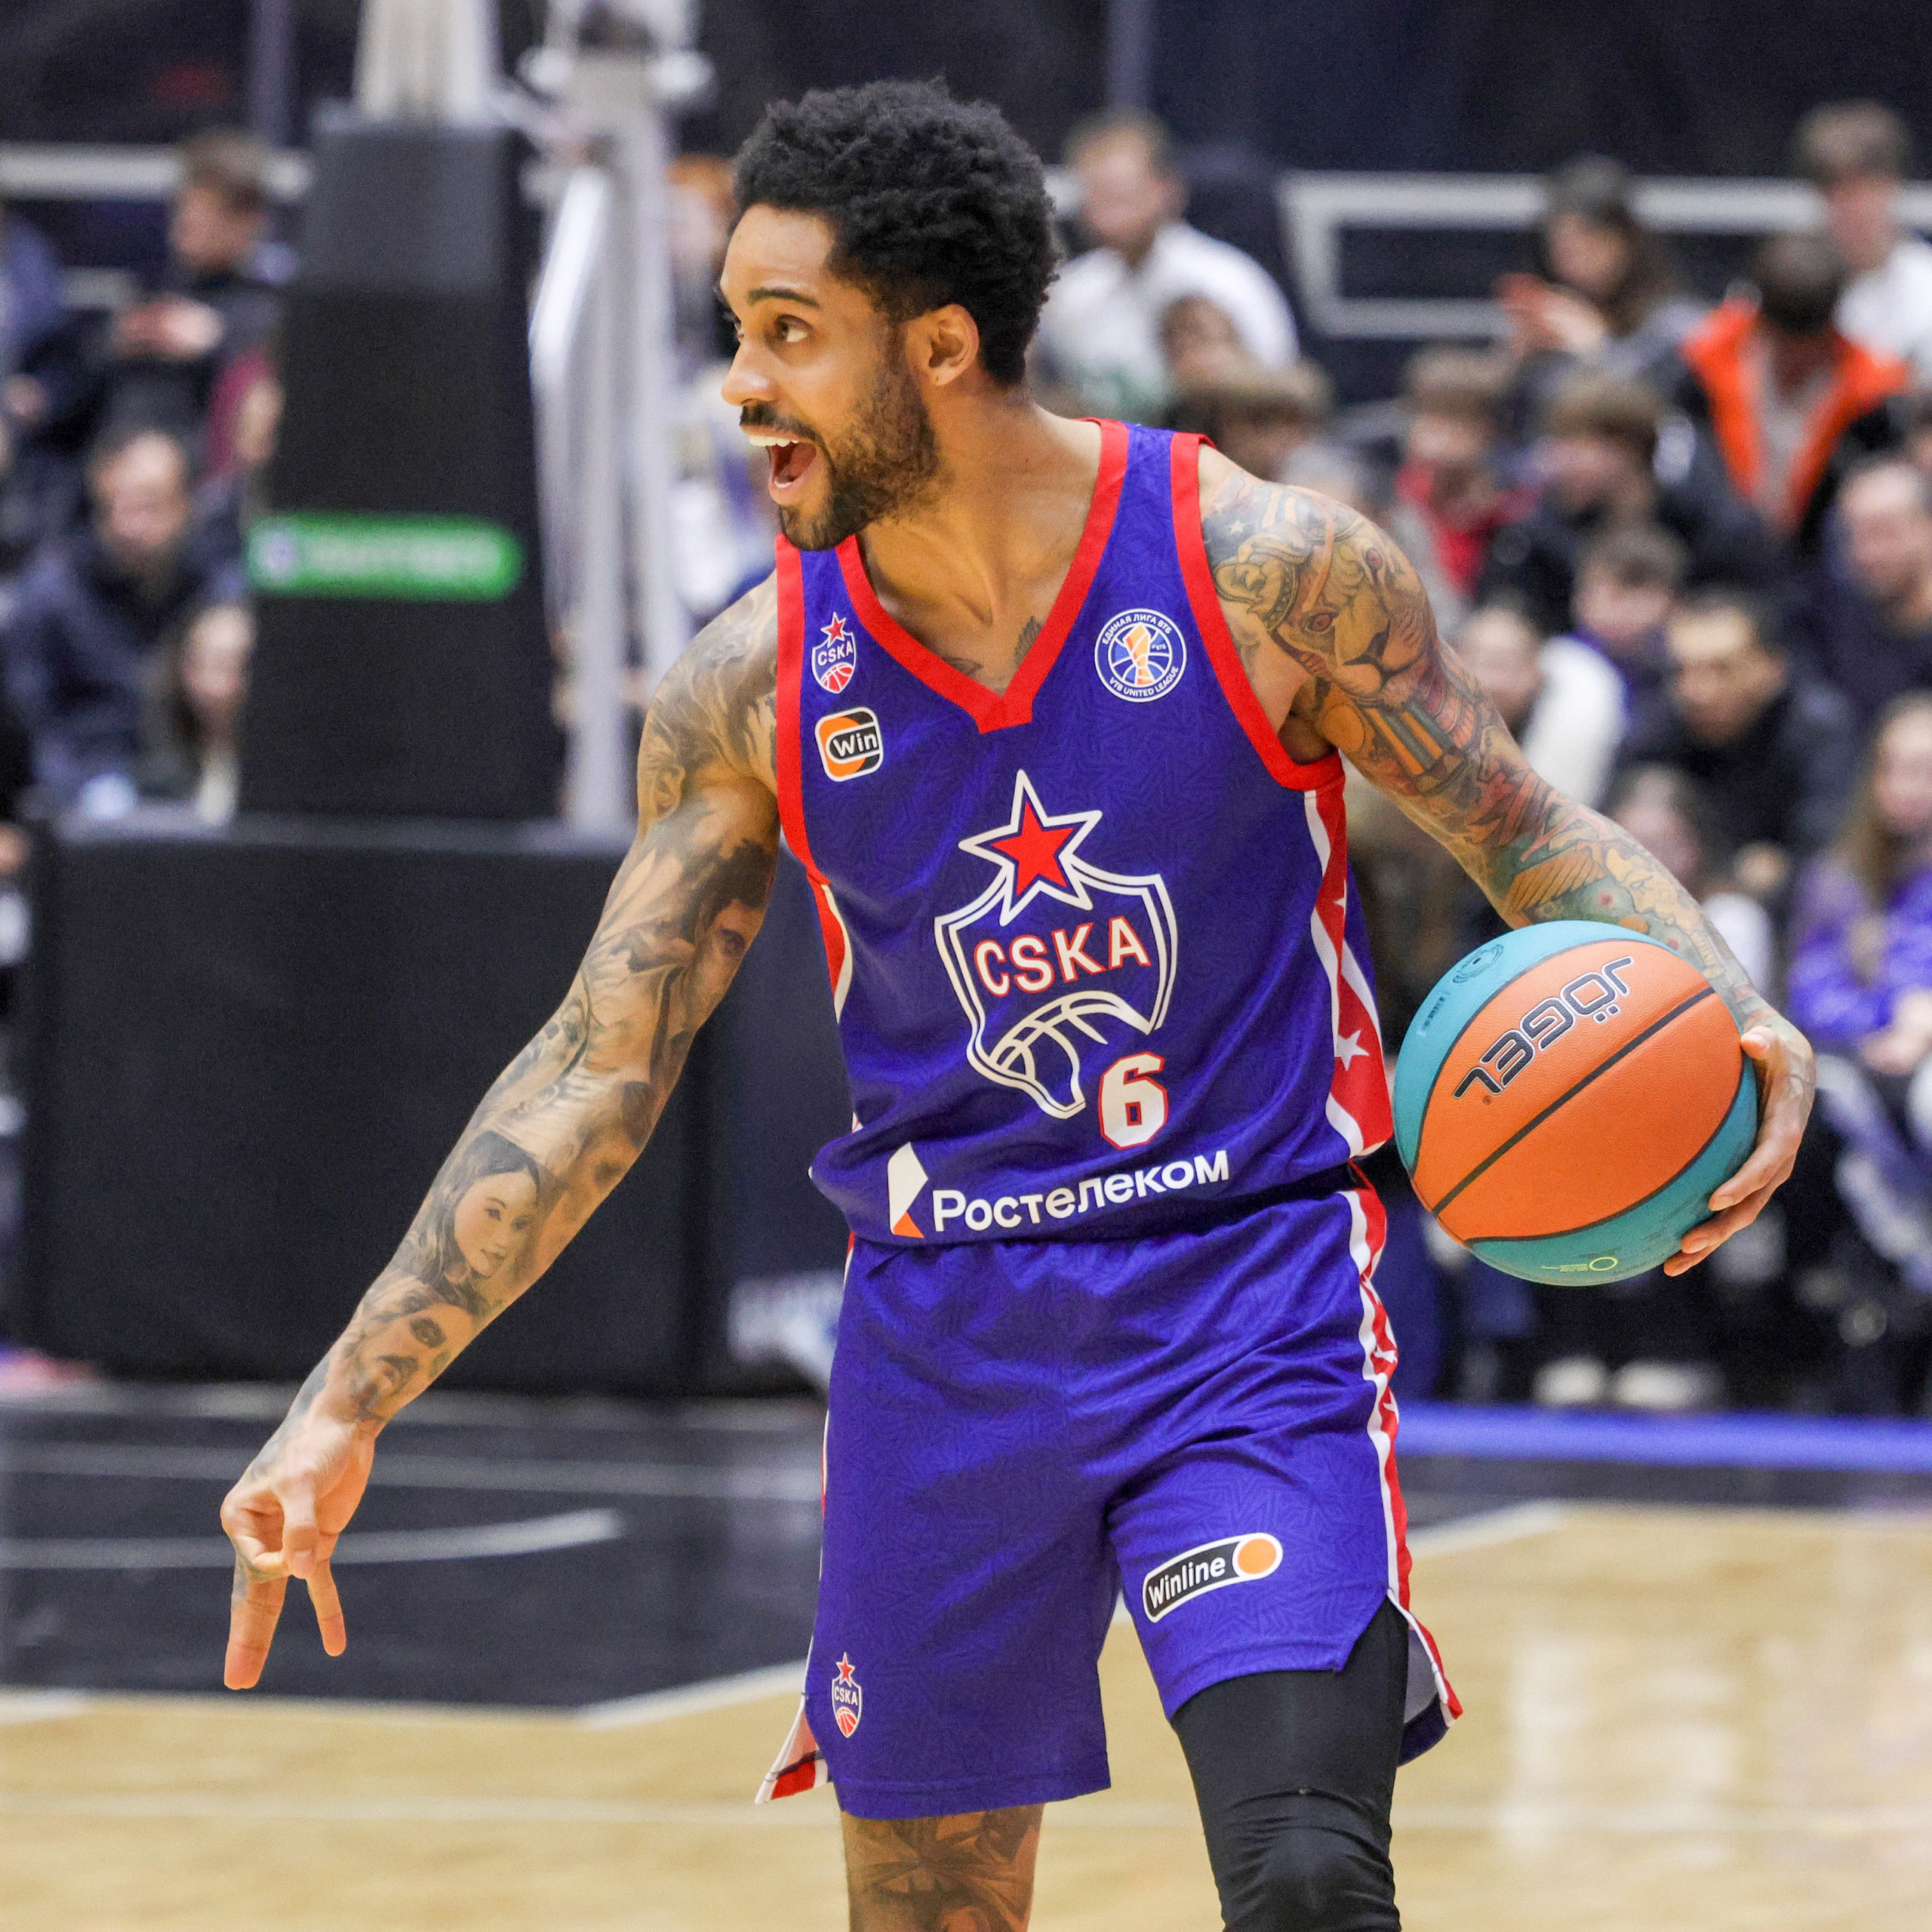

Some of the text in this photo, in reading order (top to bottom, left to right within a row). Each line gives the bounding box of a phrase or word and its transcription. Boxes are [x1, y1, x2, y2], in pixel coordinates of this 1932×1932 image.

[1102, 613, 1173, 645] ЕДИНАЯ ЛИГА ВТБ
[817, 640, 854, 666] CSKA
[1109, 666, 1179, 697] VTB UNITED LEAGUE
[832, 732, 878, 757] Win
[974, 915, 1151, 998] CSKA
[1451, 955, 1635, 1100] JÖGEL
[1097, 1051, 1169, 1151] 6
[932, 1149, 1230, 1232] Ростелеком
[1148, 1556, 1226, 1609] Winline
[834, 1686, 858, 1706] CSKA
